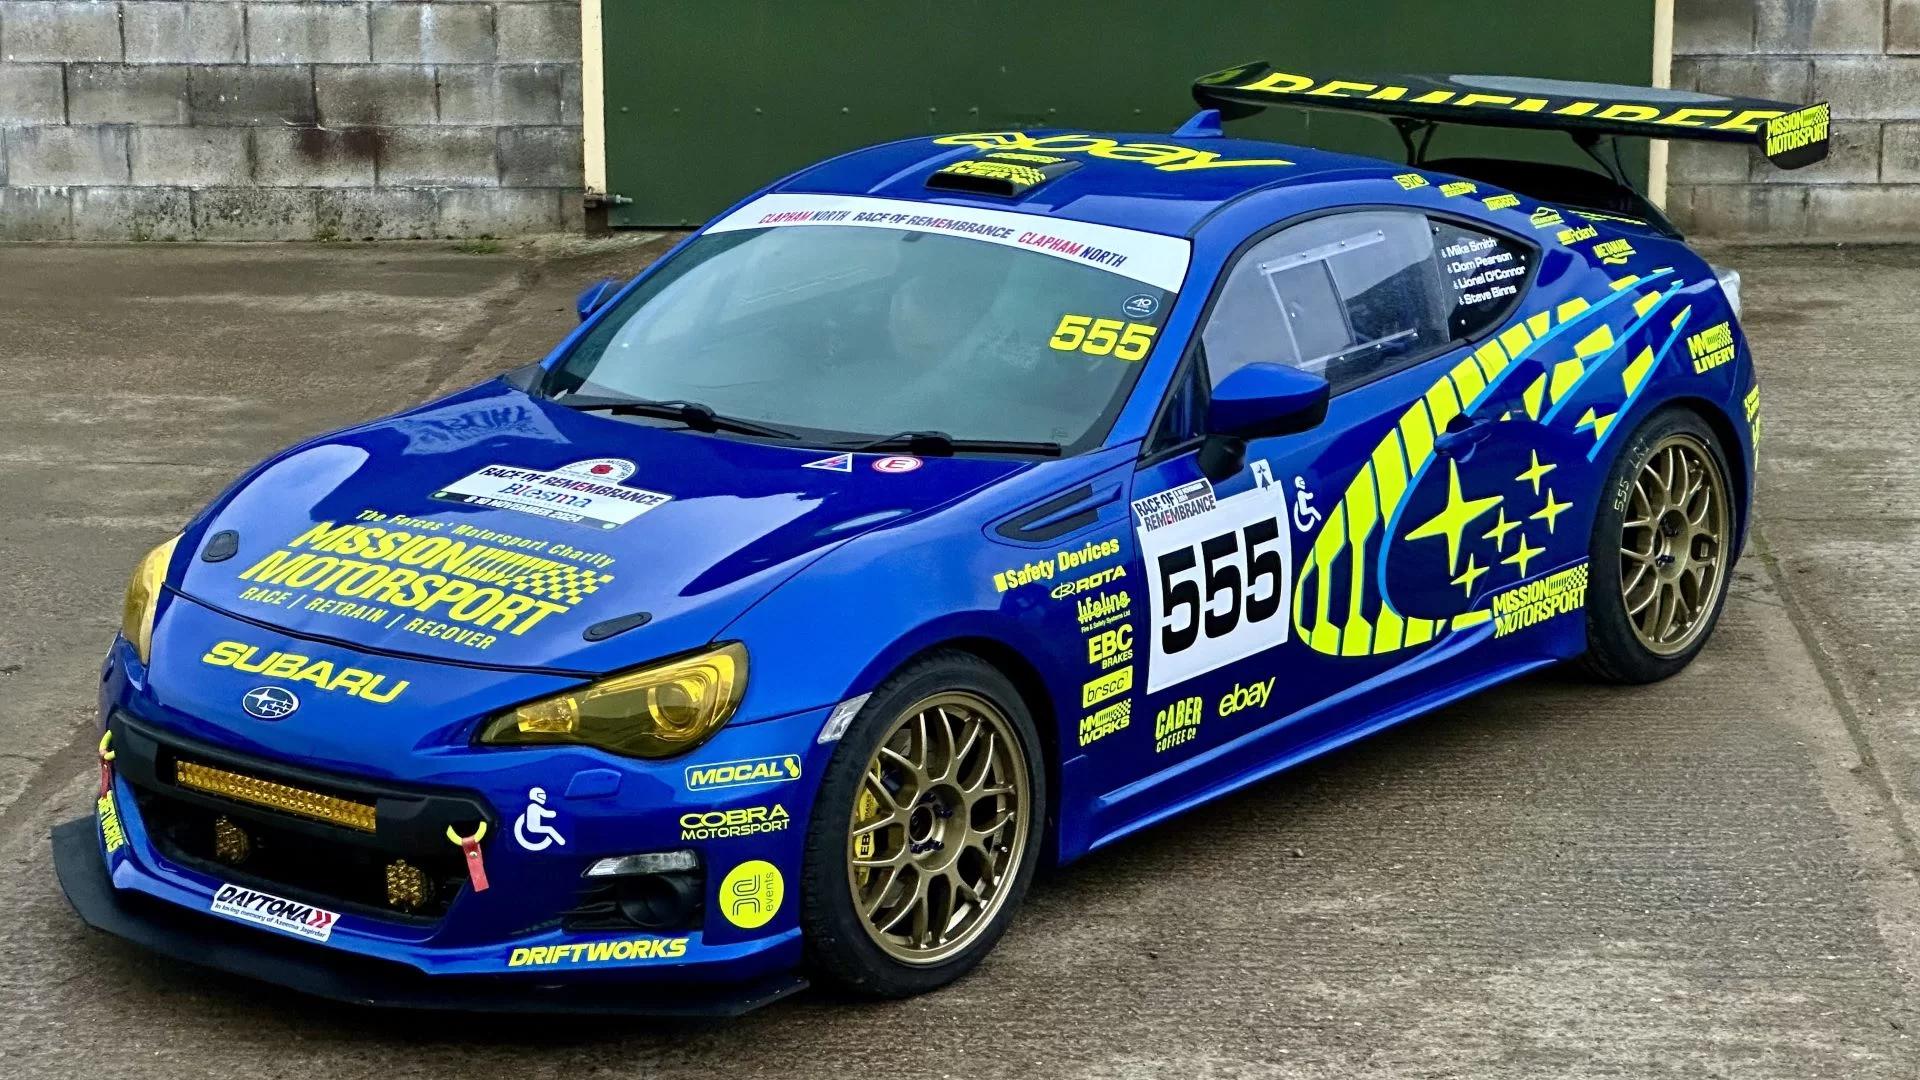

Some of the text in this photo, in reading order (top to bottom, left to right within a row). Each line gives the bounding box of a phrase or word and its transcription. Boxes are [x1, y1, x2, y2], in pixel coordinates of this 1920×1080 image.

[1766, 109, 1804, 139] MISSION
[1767, 121, 1829, 157] MOTORSPORT
[758, 211, 851, 224] CLAPHAM NORTH
[852, 212, 1015, 239] RACE OF REMEMBRANCE
[1018, 231, 1128, 268] CLAPHAM NORTH
[1446, 237, 1497, 257] Mike Smith
[1452, 252, 1513, 273] Dom Pearson
[1458, 265, 1526, 289] Lionel O'Connor
[1463, 285, 1517, 305] Steve Binns
[1049, 314, 1158, 361] 555
[1694, 344, 1735, 374] LIVERY
[884, 459, 911, 469] E
[479, 467, 521, 481] RACE
[519, 473, 543, 485] OF
[540, 477, 665, 506] REMEMBRANCE
[498, 483, 593, 508] Blesma
[1614, 476, 1629, 513] 555
[486, 499, 551, 517] NOVEMBER
[549, 511, 585, 523] 2024
[1134, 496, 1161, 517] RACE
[1160, 491, 1175, 508] OF
[1144, 494, 1217, 532] REMEMBRANCE
[288, 521, 476, 574] MISSION
[356, 509, 387, 522] The
[451, 524, 550, 550] Motorsport
[548, 544, 616, 568] Charity
[1005, 538, 1120, 589] Safety Devices
[238, 550, 568, 637] MOTORSPORT
[1076, 565, 1127, 594] ROTA
[1157, 516, 1282, 655] 555
[1493, 579, 1551, 617] MISSION
[1494, 585, 1588, 639] MOTORSPORT
[238, 587, 292, 606] RACE
[305, 597, 388, 623] RETRAIN
[403, 617, 497, 650] RECOVER
[1088, 623, 1133, 665] EBC
[1101, 648, 1133, 669] BRAKES
[202, 640, 410, 704] SUBARU
[1087, 677, 1125, 703] brscc
[1218, 676, 1277, 718] ebay
[1079, 714, 1130, 747] WORKS
[1155, 696, 1203, 741] CABER
[1156, 728, 1186, 753] COFFEE
[690, 762, 784, 787] MOCAL
[679, 803, 790, 829] COBRA
[681, 818, 791, 841] MOTORSPORT
[860, 832, 871, 856] EB
[216, 886, 314, 924] DAYTONA
[764, 871, 775, 912] events
[222, 904, 240, 915] loving
[241, 910, 266, 922] memory
[266, 916, 275, 924] of
[508, 937, 690, 967] DRIFTWORKS
